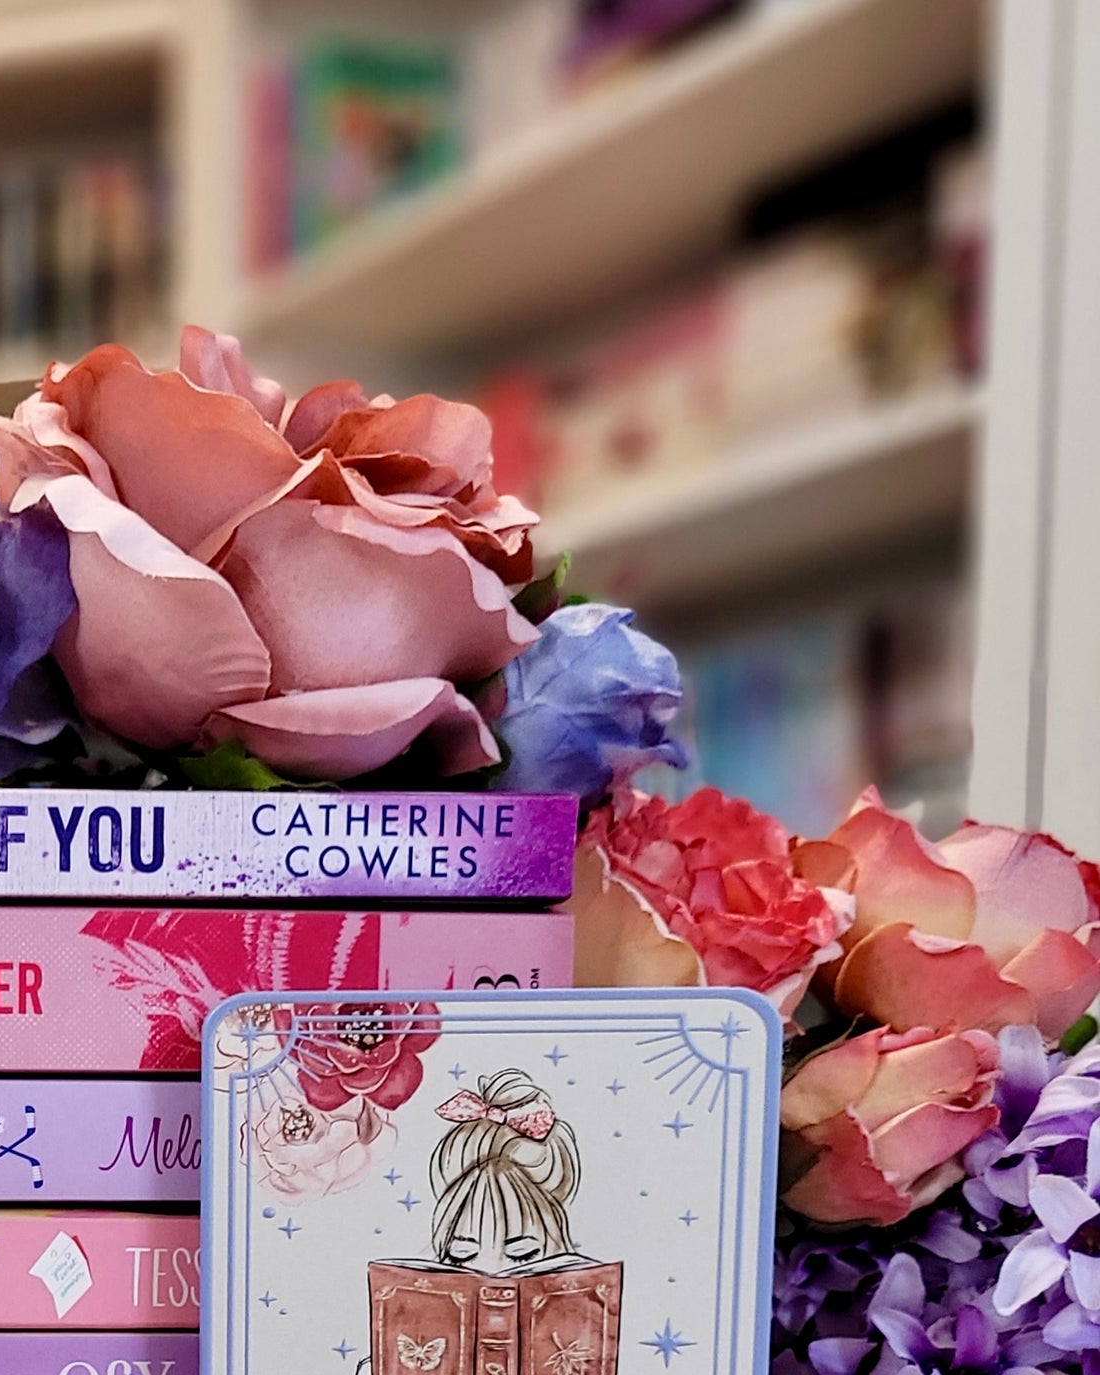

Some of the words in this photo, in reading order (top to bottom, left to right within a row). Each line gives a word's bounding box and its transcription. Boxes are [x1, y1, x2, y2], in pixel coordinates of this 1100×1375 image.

[251, 803, 516, 839] CATHERINE
[47, 805, 166, 874] YOU
[284, 845, 478, 880] COWLES
